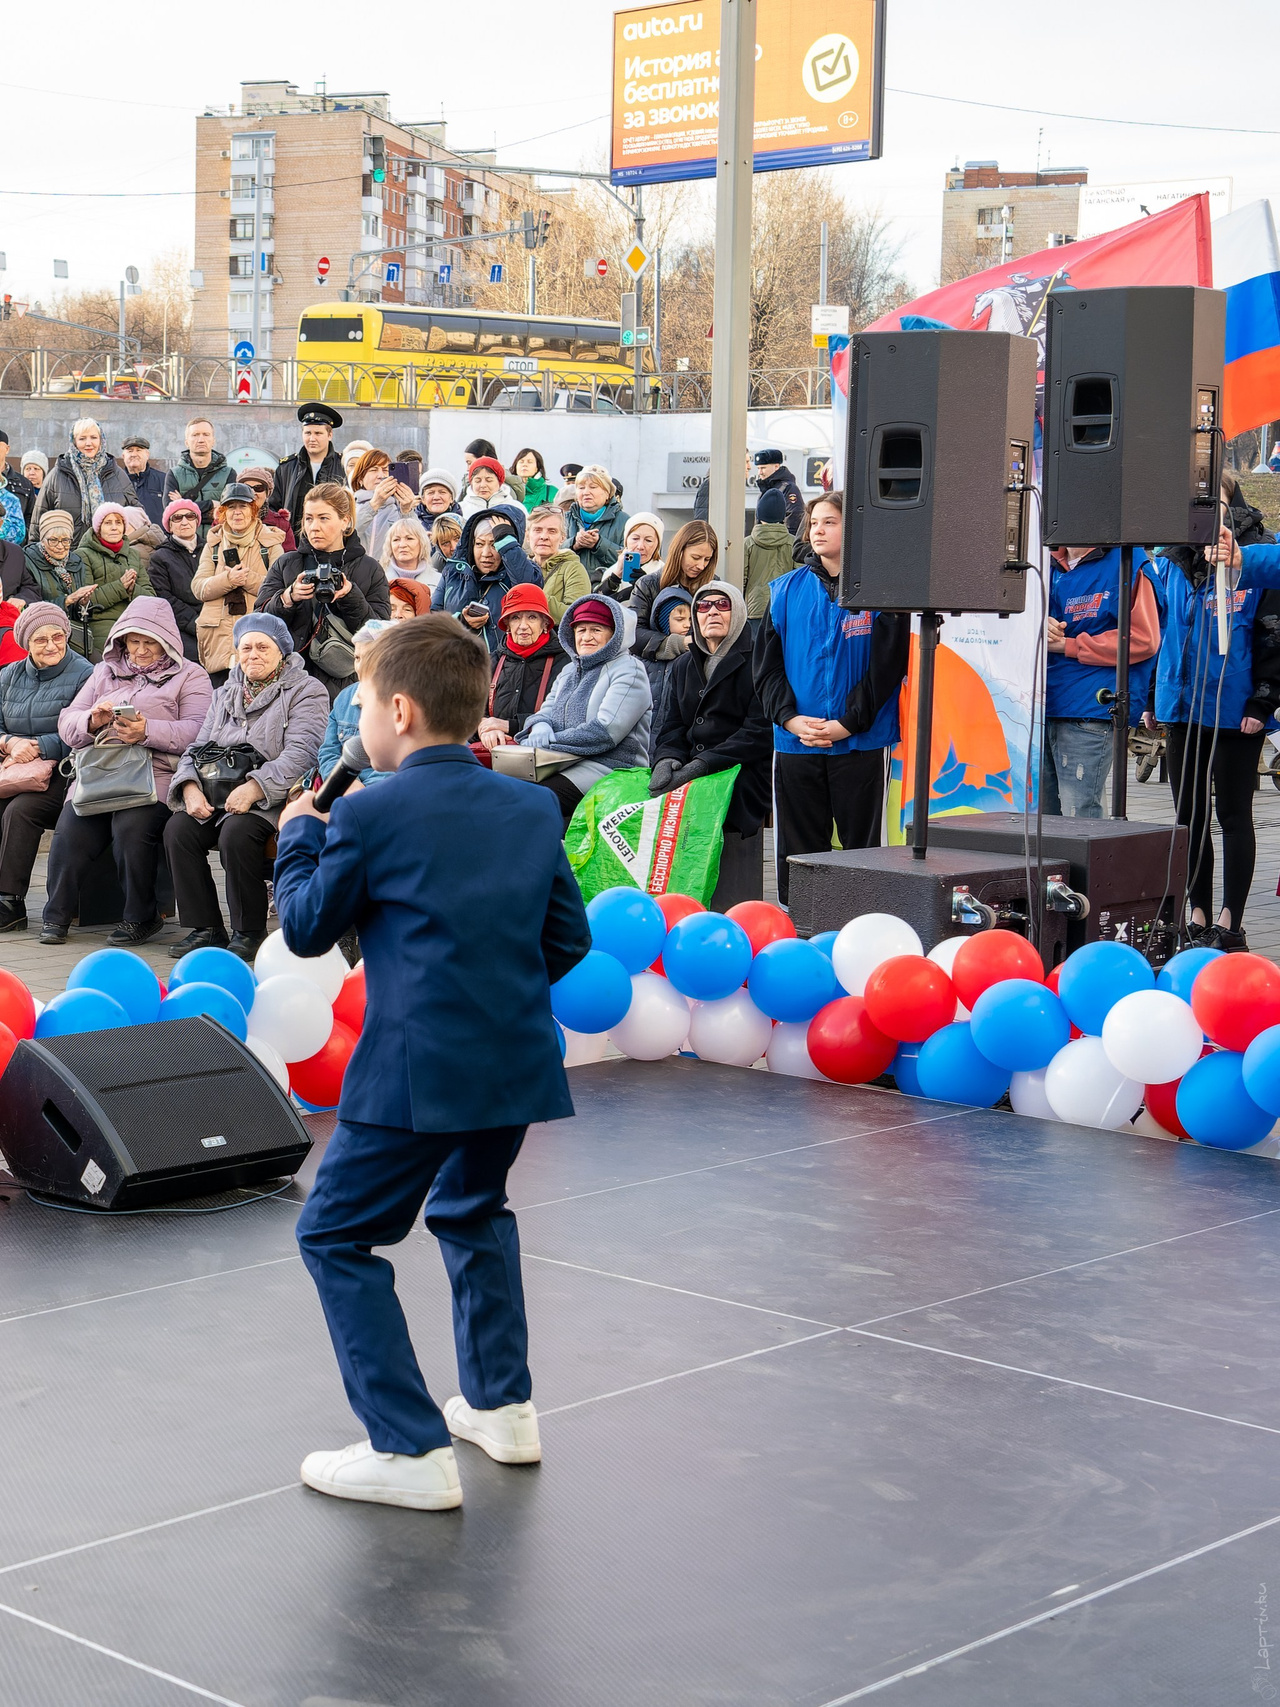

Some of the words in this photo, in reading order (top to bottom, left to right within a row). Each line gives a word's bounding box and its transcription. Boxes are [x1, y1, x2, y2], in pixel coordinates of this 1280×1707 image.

[623, 12, 703, 41] auto.ru
[624, 51, 712, 80] История
[623, 110, 645, 129] за
[648, 100, 720, 126] звонок
[670, 782, 688, 801] ЦЕ
[662, 801, 681, 839] НИЗКИЕ
[606, 830, 636, 863] LEROY
[651, 839, 674, 894] БЕССПОРНО
